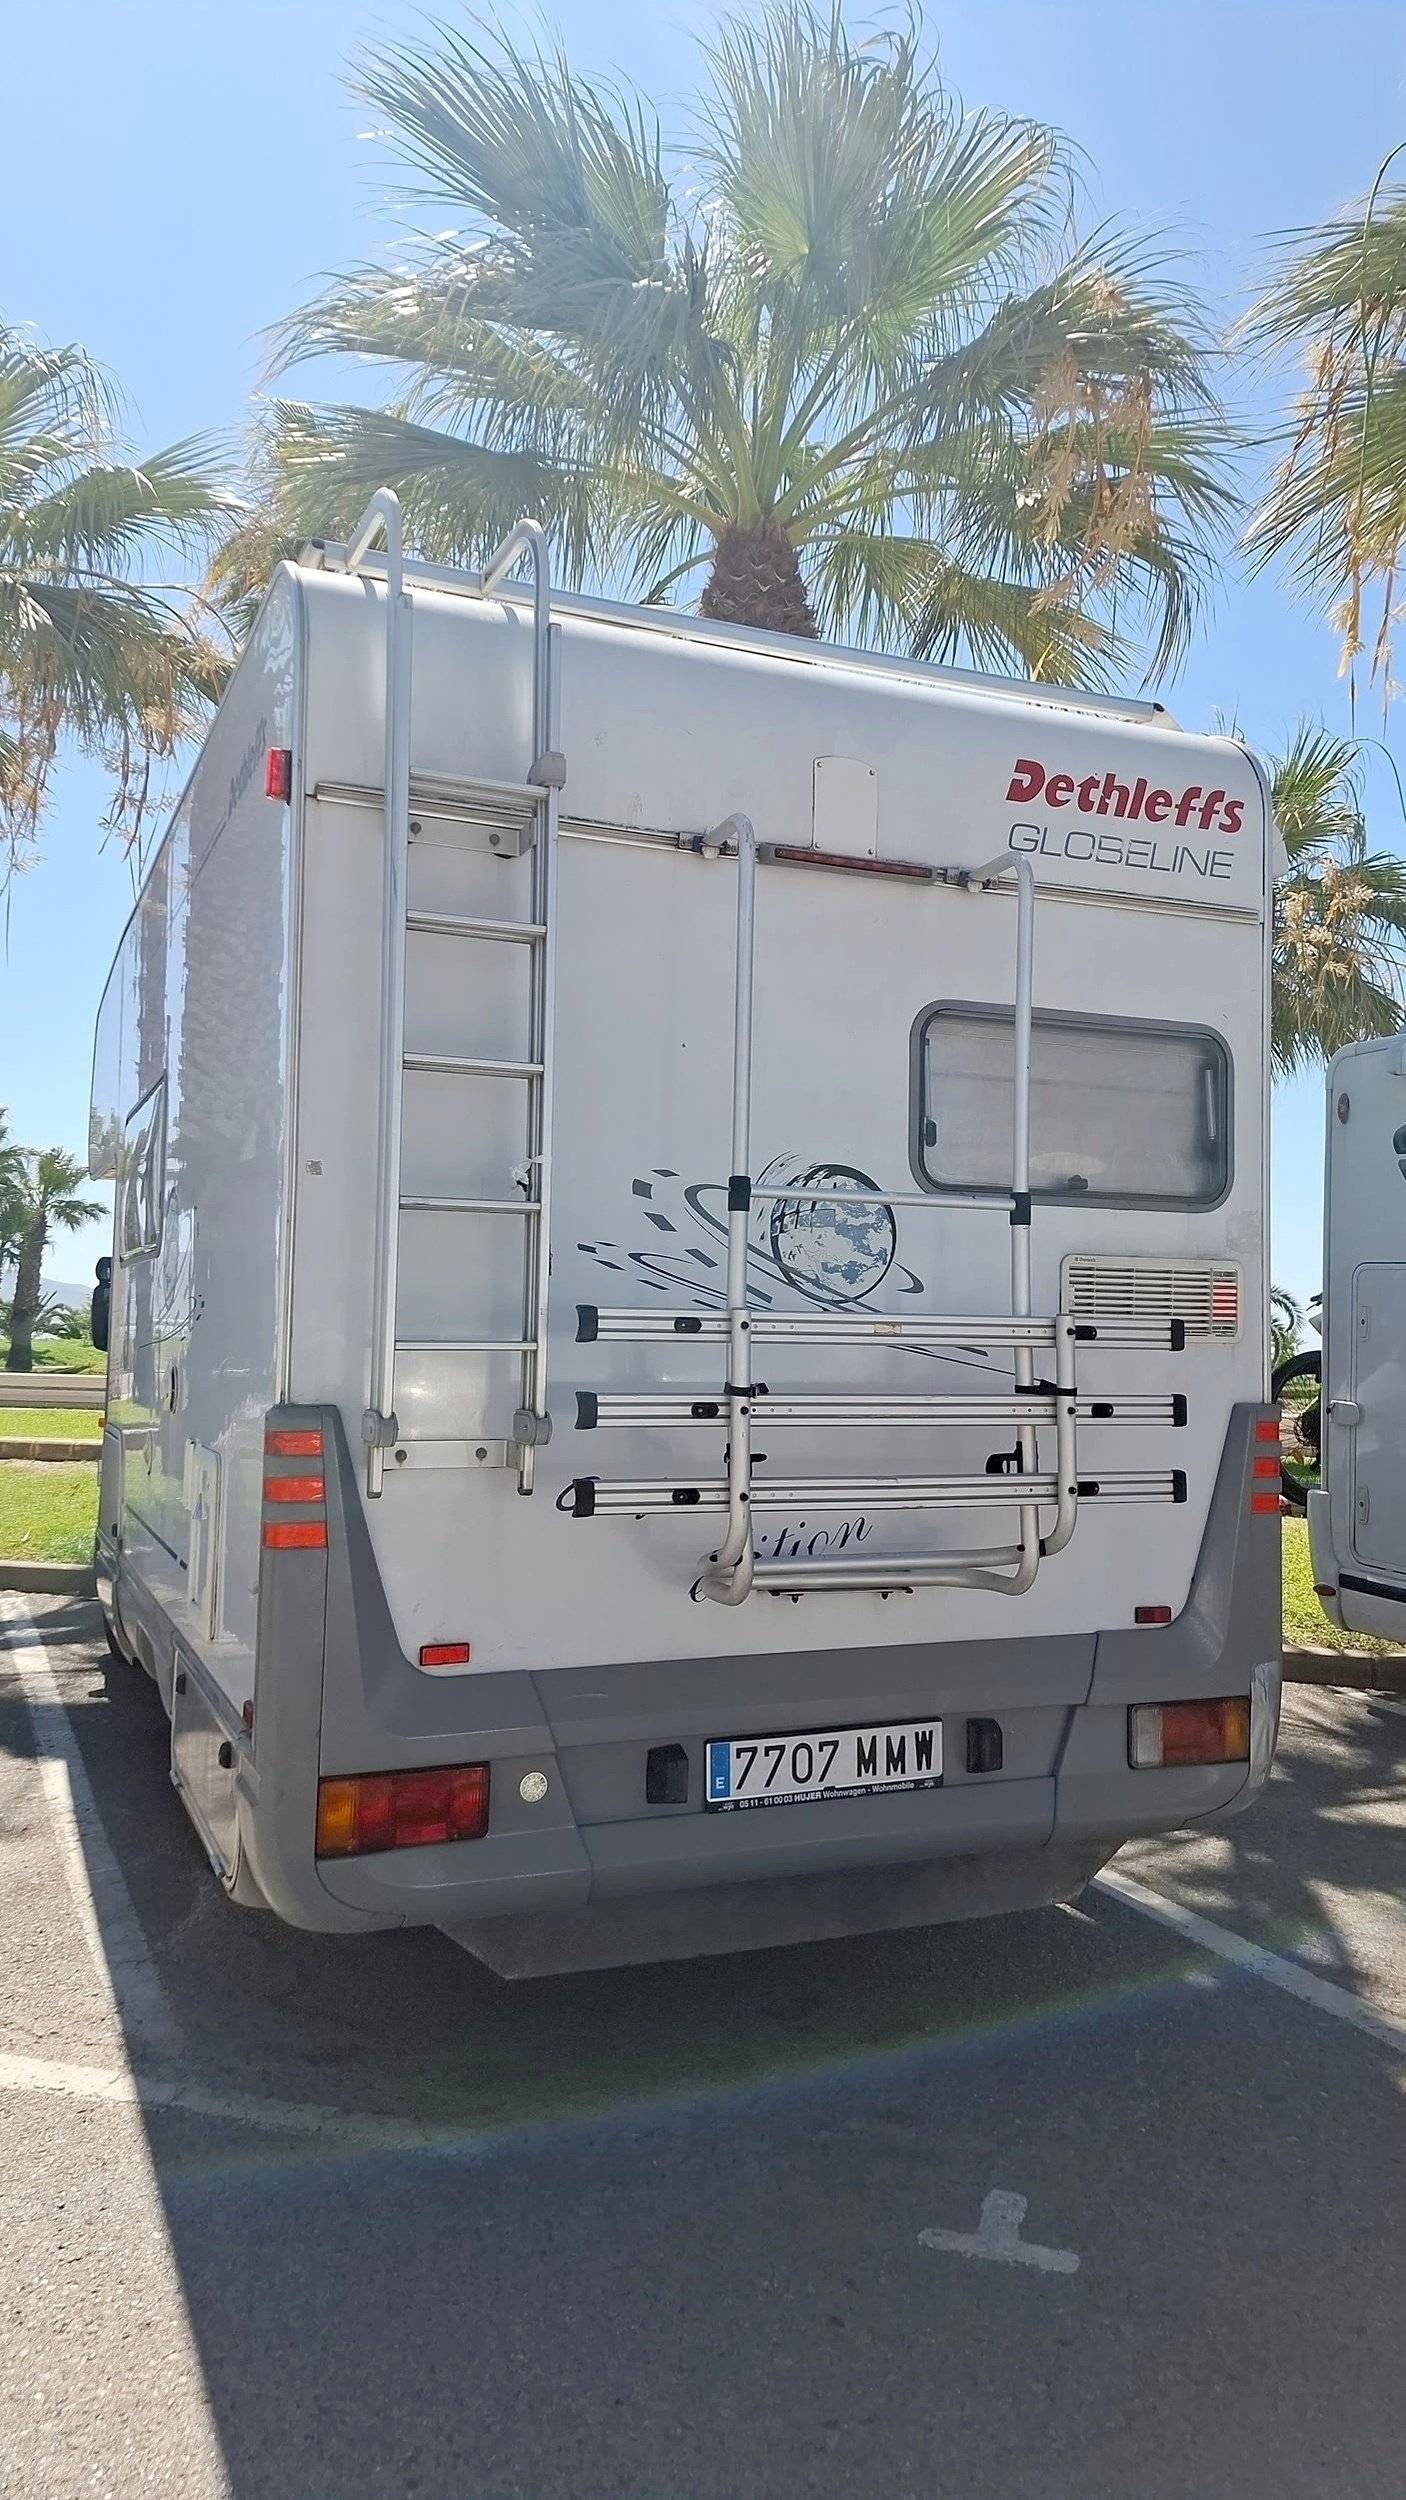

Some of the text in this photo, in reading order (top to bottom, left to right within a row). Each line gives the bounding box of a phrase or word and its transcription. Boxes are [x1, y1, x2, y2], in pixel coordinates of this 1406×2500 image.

[1005, 758, 1245, 834] Dethleffs
[1008, 822, 1235, 880] GLOBELINE
[715, 1776, 725, 1789] E
[735, 1729, 934, 1790] 7707 MMW
[794, 1792, 822, 1802] HUJER
[822, 1787, 866, 1799] Wohnwagen
[871, 1781, 915, 1793] Wohnmobile
